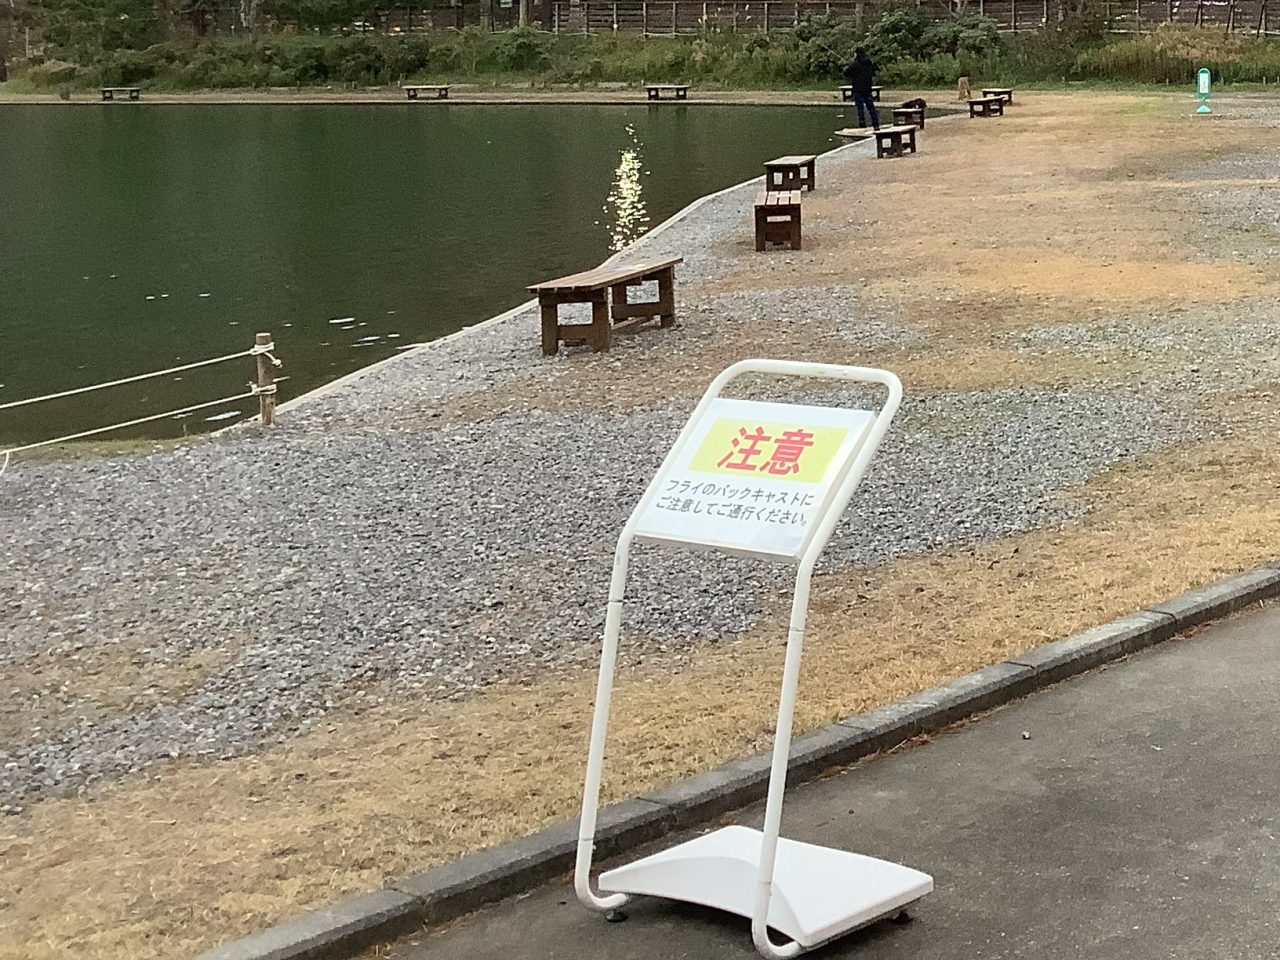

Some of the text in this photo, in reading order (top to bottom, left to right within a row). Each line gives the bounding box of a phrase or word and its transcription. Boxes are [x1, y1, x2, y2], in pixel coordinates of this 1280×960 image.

[717, 426, 815, 476] 注意
[666, 479, 815, 506] フライのバックキャストに
[656, 495, 808, 527] ご注意してご通行ください。
